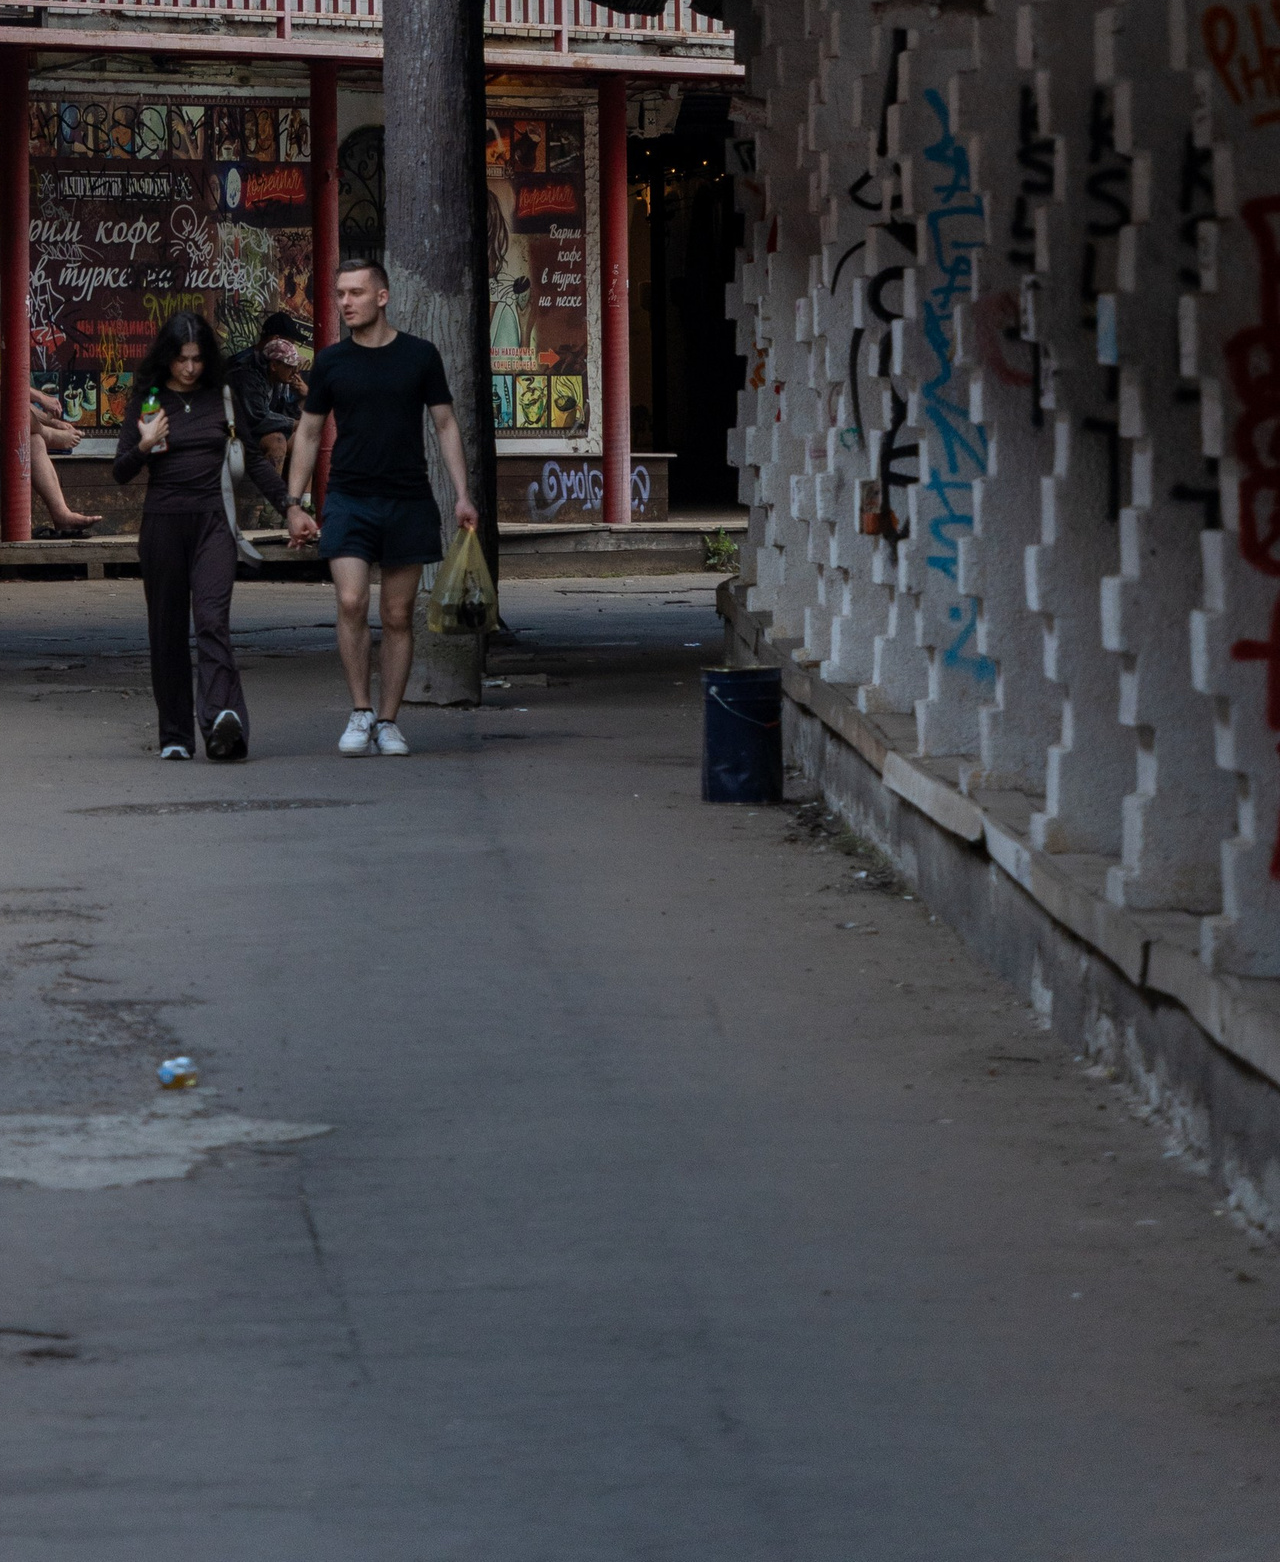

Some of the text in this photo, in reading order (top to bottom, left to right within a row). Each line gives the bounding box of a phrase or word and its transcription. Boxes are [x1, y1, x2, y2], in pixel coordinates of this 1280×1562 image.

[95, 214, 162, 260] кофе
[549, 223, 582, 246] Варим
[557, 245, 582, 269] кофе
[58, 262, 132, 302] турке
[541, 267, 582, 291] в турке
[538, 294, 582, 308] на песке
